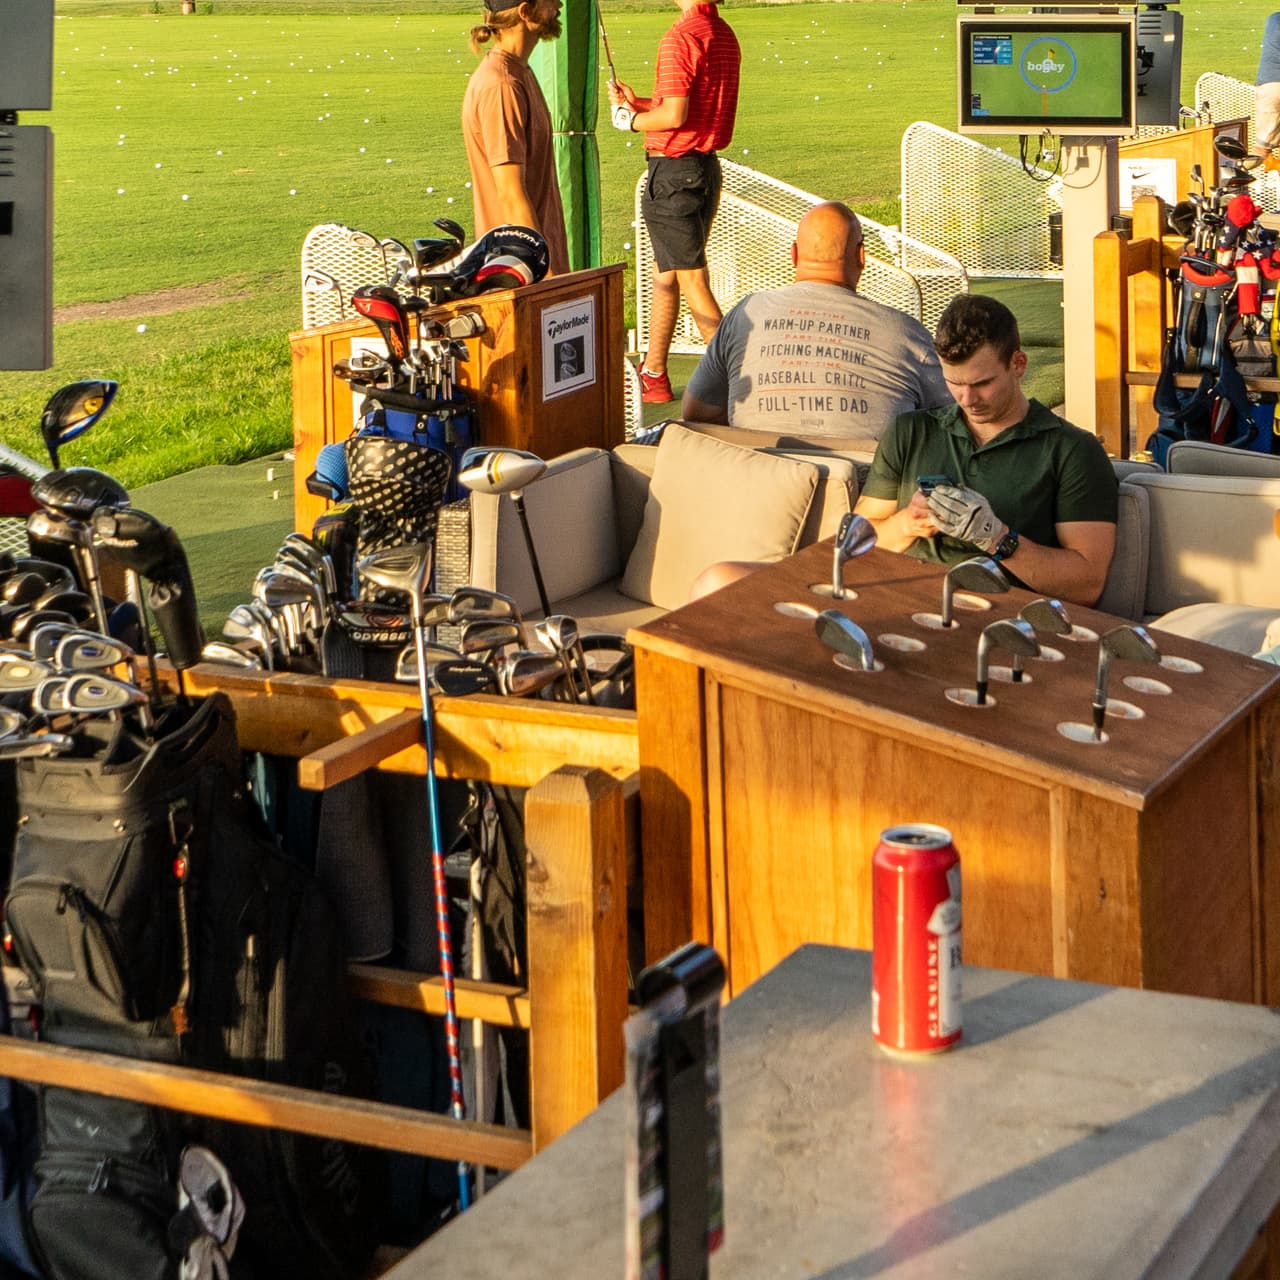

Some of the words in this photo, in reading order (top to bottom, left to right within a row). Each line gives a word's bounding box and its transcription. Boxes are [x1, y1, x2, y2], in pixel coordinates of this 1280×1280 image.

[1027, 61, 1065, 74] bogey
[548, 314, 590, 339] TaylorMade
[763, 318, 815, 331] WARM-UP
[818, 321, 871, 341] PARTNER
[760, 344, 813, 357] PITCHING
[815, 346, 869, 366] MACHINE
[758, 371, 817, 386] BASEBALL
[824, 372, 867, 389] CRITIC
[758, 396, 835, 413] FULL-TIME
[839, 397, 869, 414] DAD
